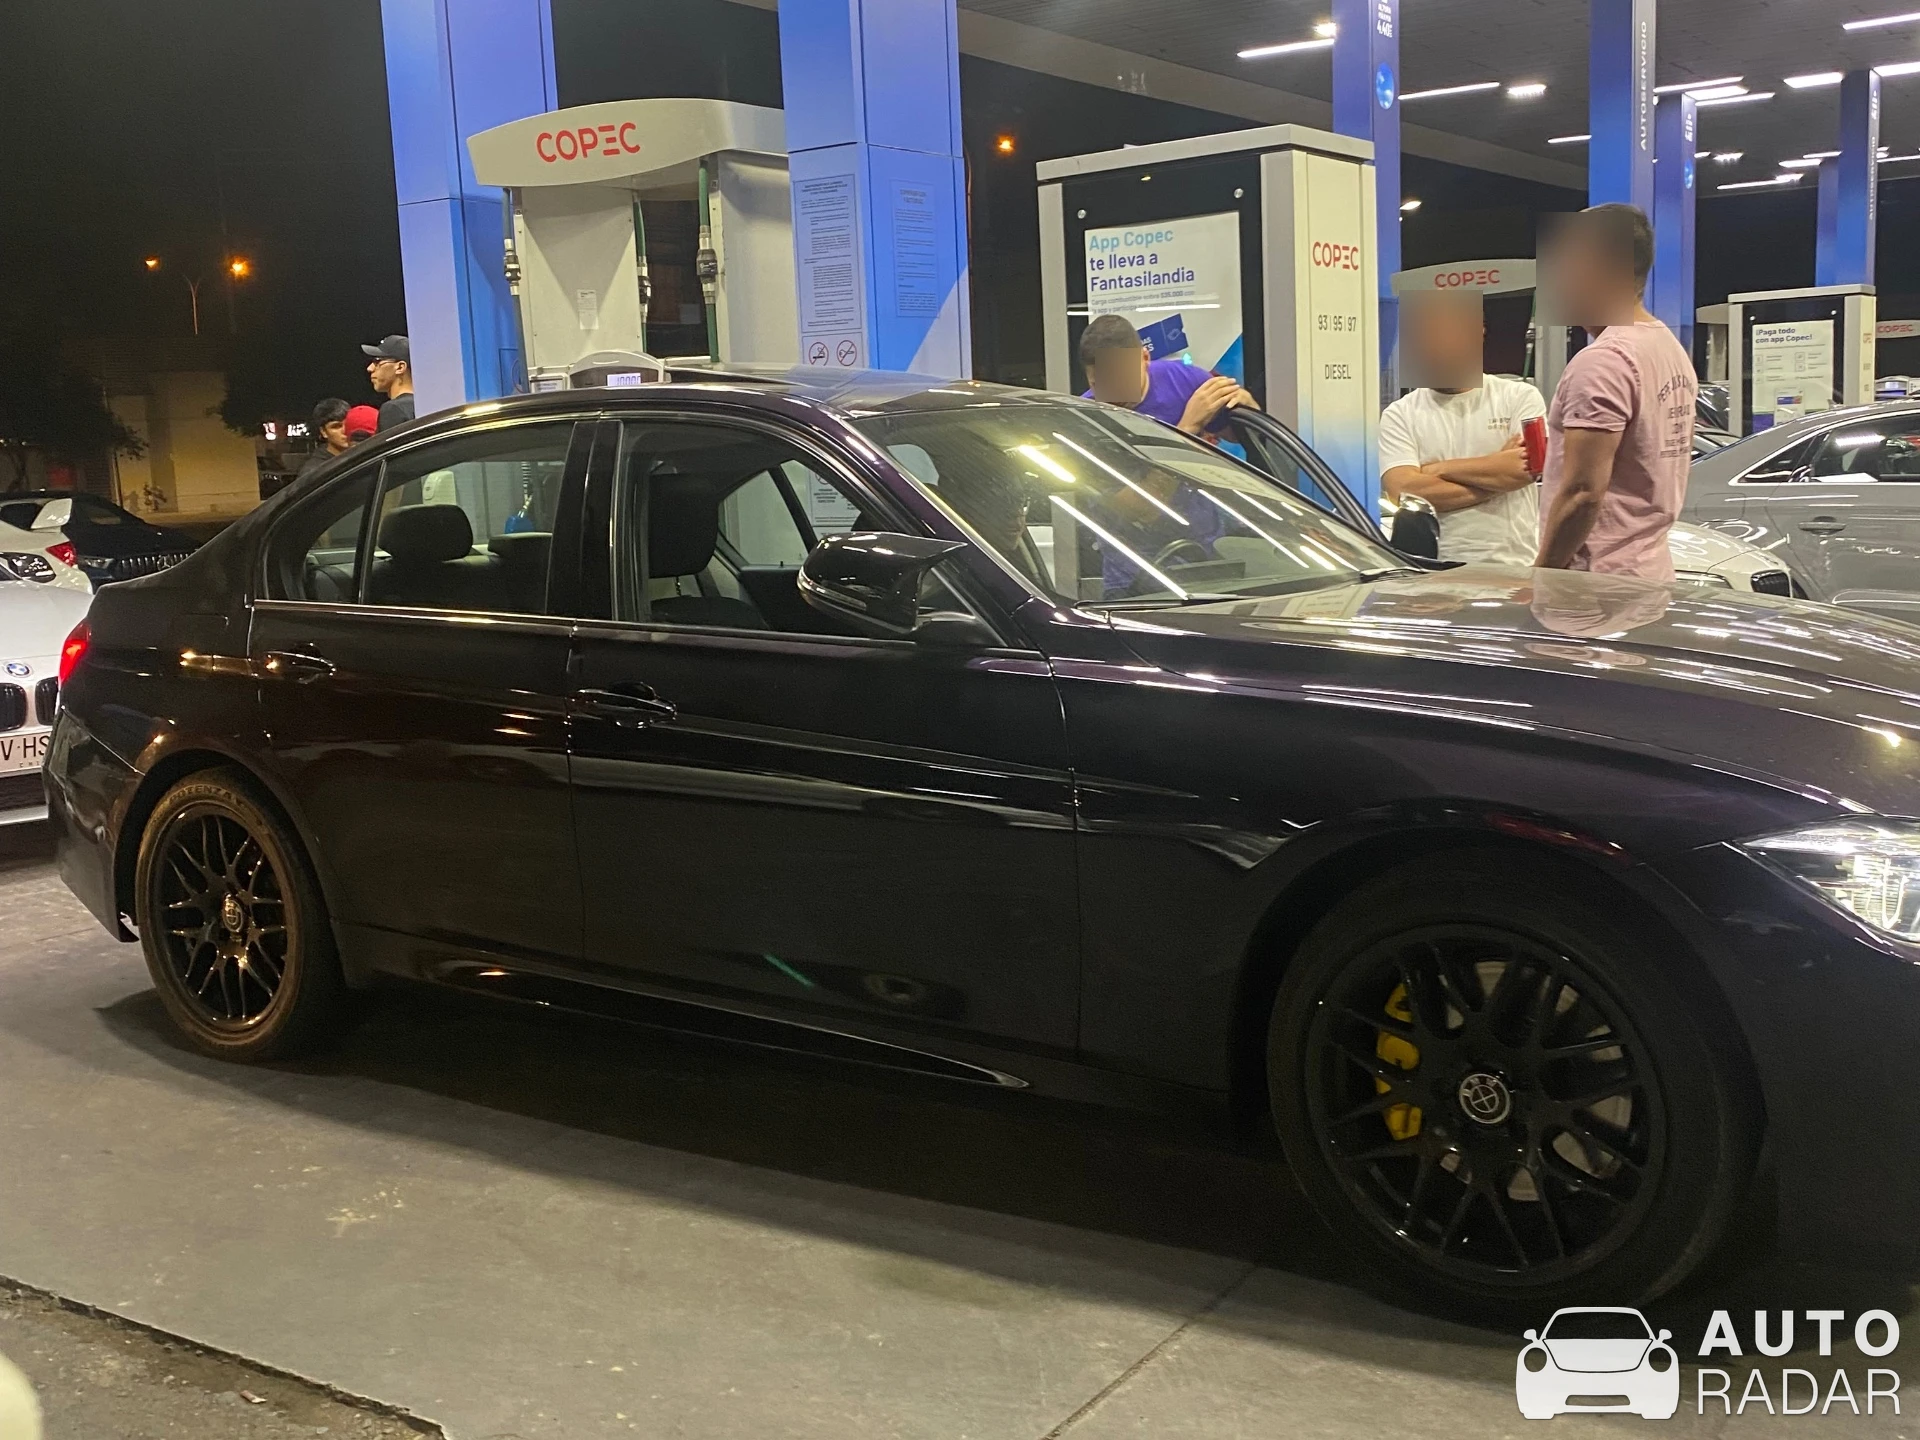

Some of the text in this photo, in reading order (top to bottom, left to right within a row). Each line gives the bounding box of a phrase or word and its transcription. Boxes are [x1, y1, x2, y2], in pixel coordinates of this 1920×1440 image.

[1640, 21, 1648, 151] AUTOSERVICIO
[536, 122, 641, 163] COPEC
[1089, 230, 1174, 253] App Copec
[1089, 253, 1158, 271] te lleva a
[1312, 241, 1359, 271] COPEC
[1091, 267, 1195, 292] Fantasilandia
[1434, 269, 1500, 288] COPEC
[1778, 327, 1796, 335] todo
[1877, 324, 1914, 334] COPEC
[1325, 364, 1352, 380] DIESEL
